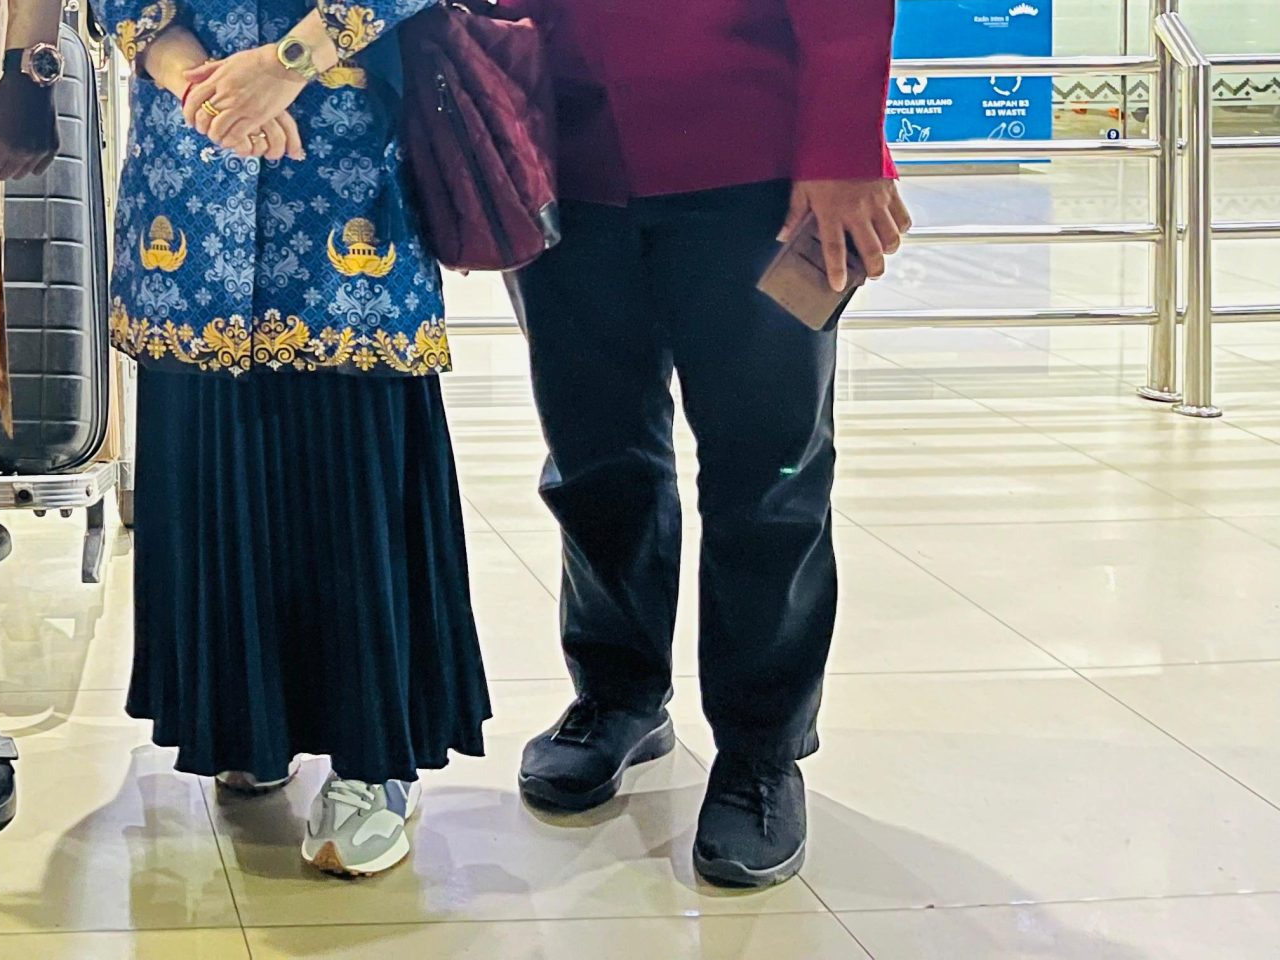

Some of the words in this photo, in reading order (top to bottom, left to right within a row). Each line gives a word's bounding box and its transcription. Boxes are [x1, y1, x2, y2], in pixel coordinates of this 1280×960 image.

[982, 100, 1018, 108] SAMPAH
[885, 107, 915, 115] ECYCLE
[997, 108, 1027, 116] WASTE
